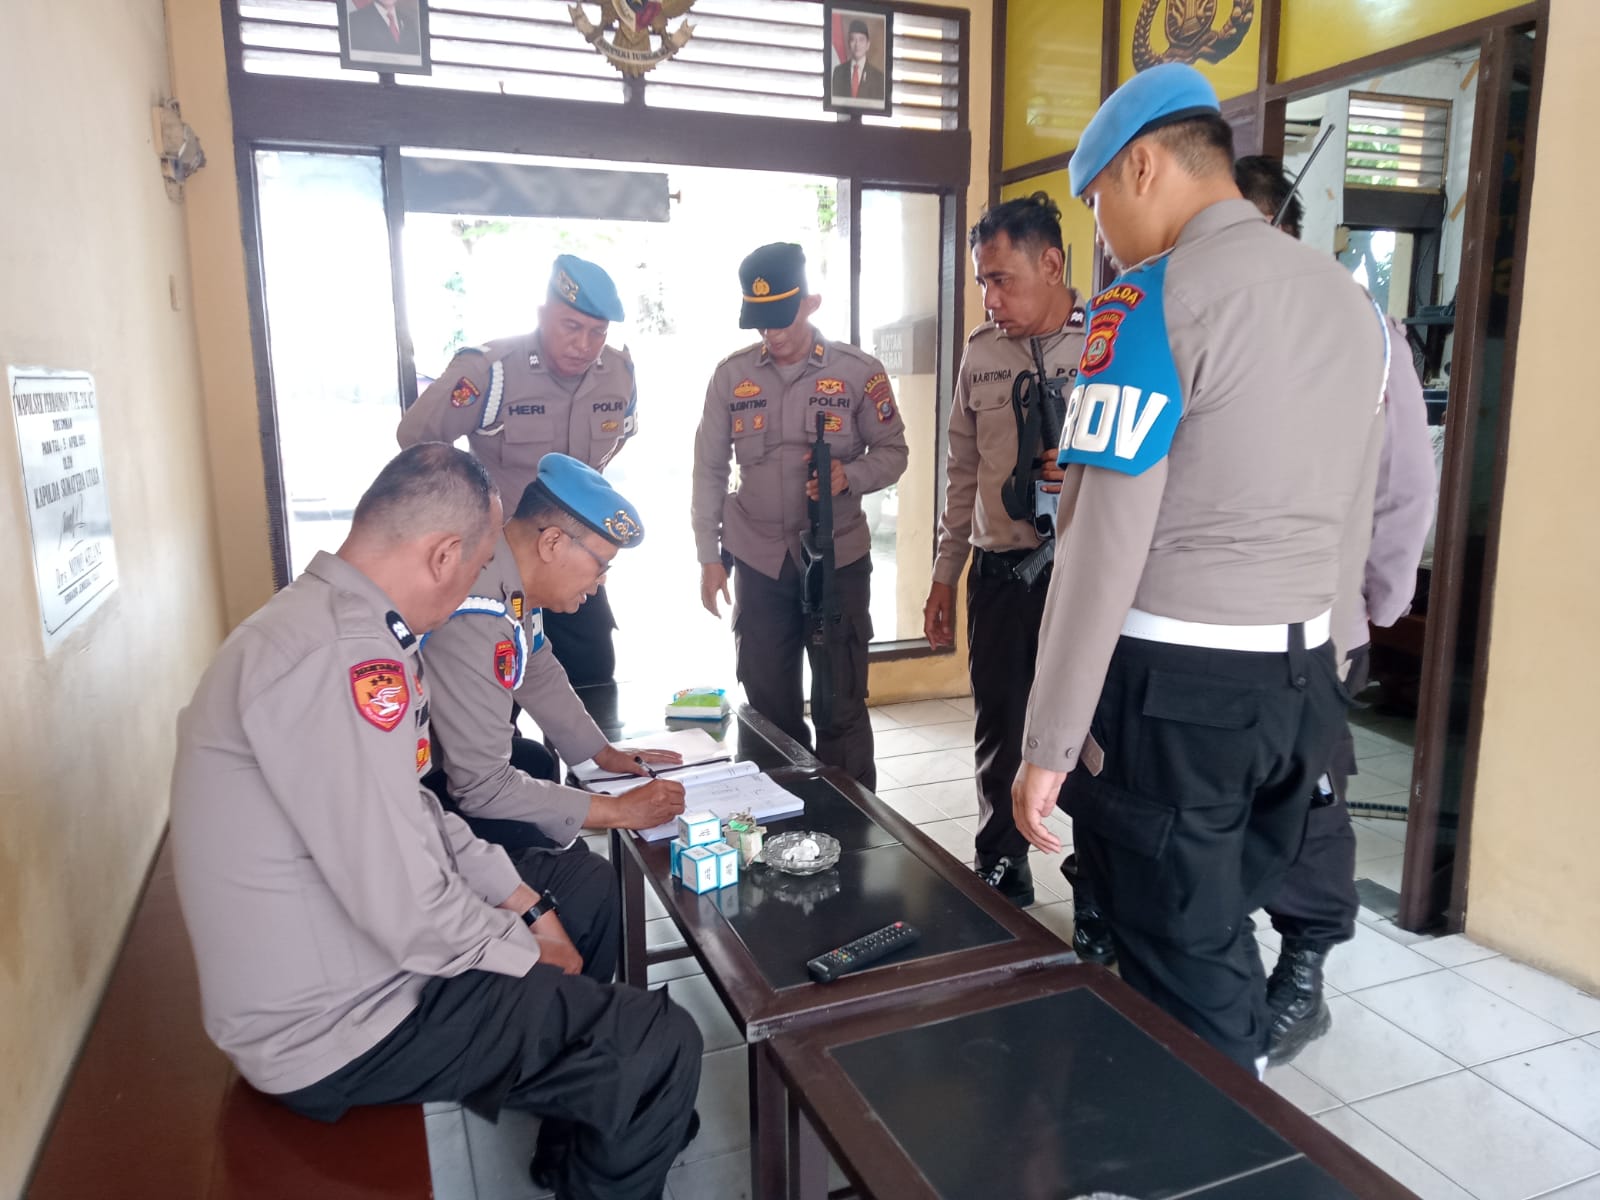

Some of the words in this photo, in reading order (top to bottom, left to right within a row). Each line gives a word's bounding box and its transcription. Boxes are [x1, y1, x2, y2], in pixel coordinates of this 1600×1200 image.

[1095, 286, 1139, 305] POLDA
[508, 404, 546, 416] HERI
[592, 402, 624, 413] POLRI
[808, 396, 850, 409] POLRI
[1059, 383, 1169, 460] ROV
[34, 481, 61, 509] KAPOLDA
